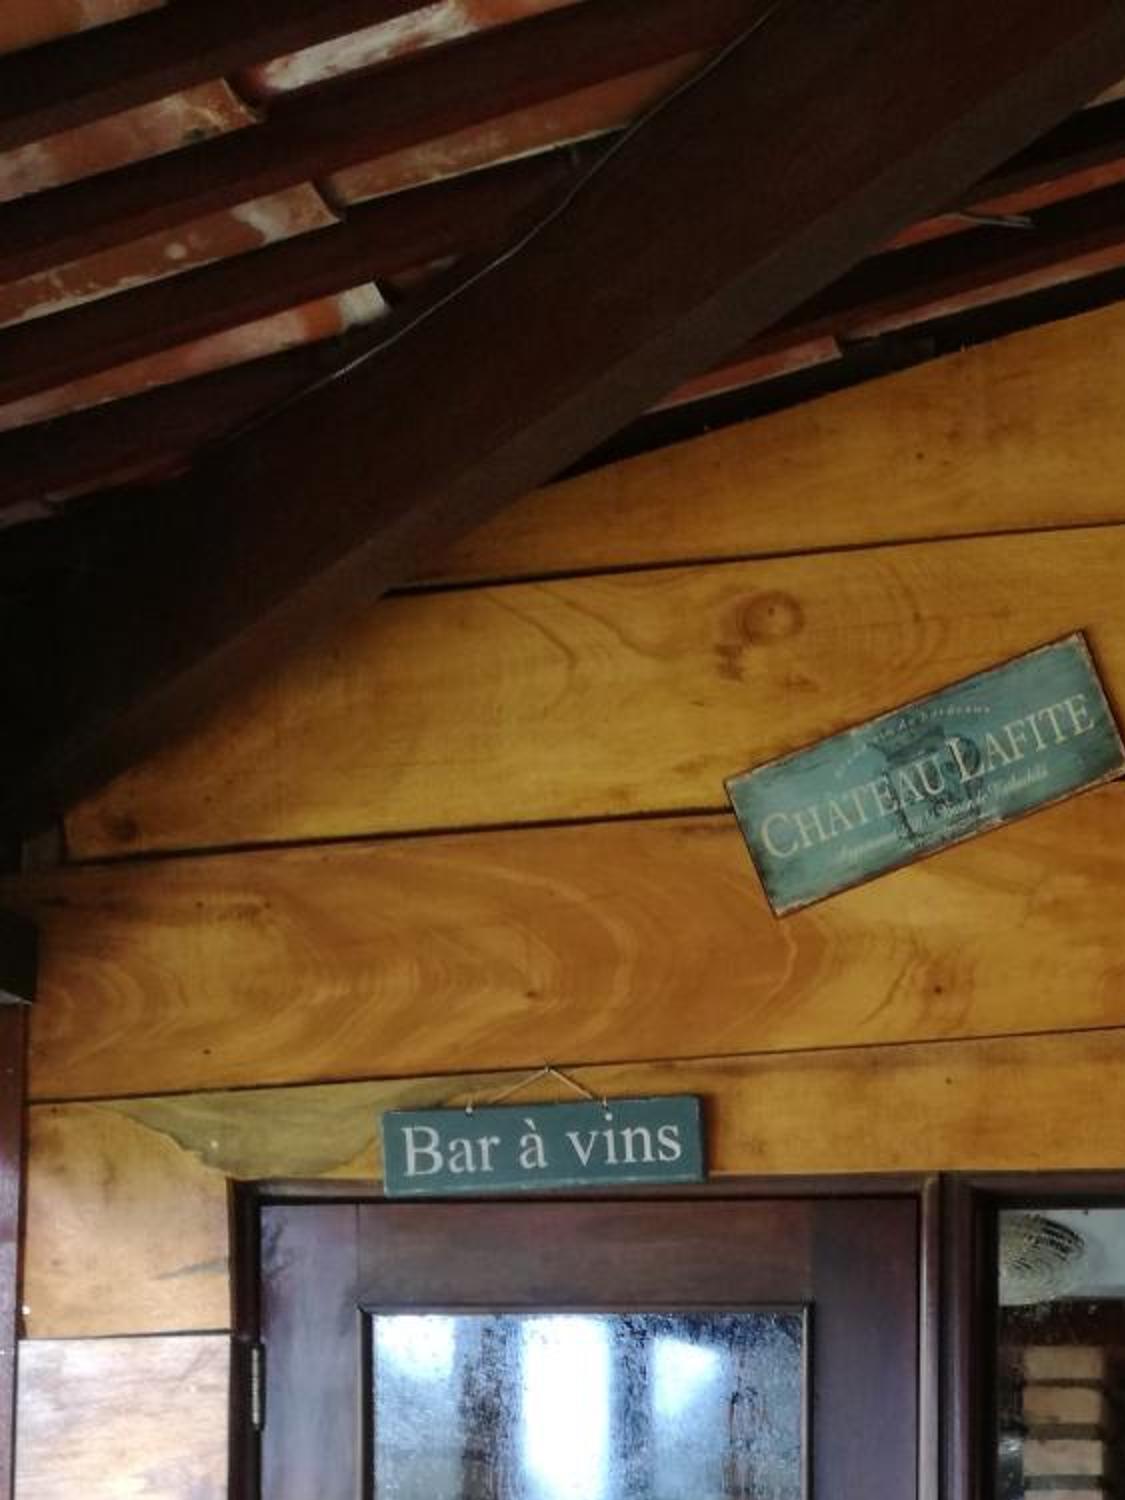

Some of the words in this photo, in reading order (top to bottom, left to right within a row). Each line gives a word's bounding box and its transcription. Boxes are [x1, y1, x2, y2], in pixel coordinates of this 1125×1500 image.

[760, 752, 946, 859] CHATEAU
[946, 693, 1096, 782] LAFITE
[402, 1125, 500, 1177] Bar
[519, 1118, 548, 1169] à
[566, 1112, 682, 1168] vins
